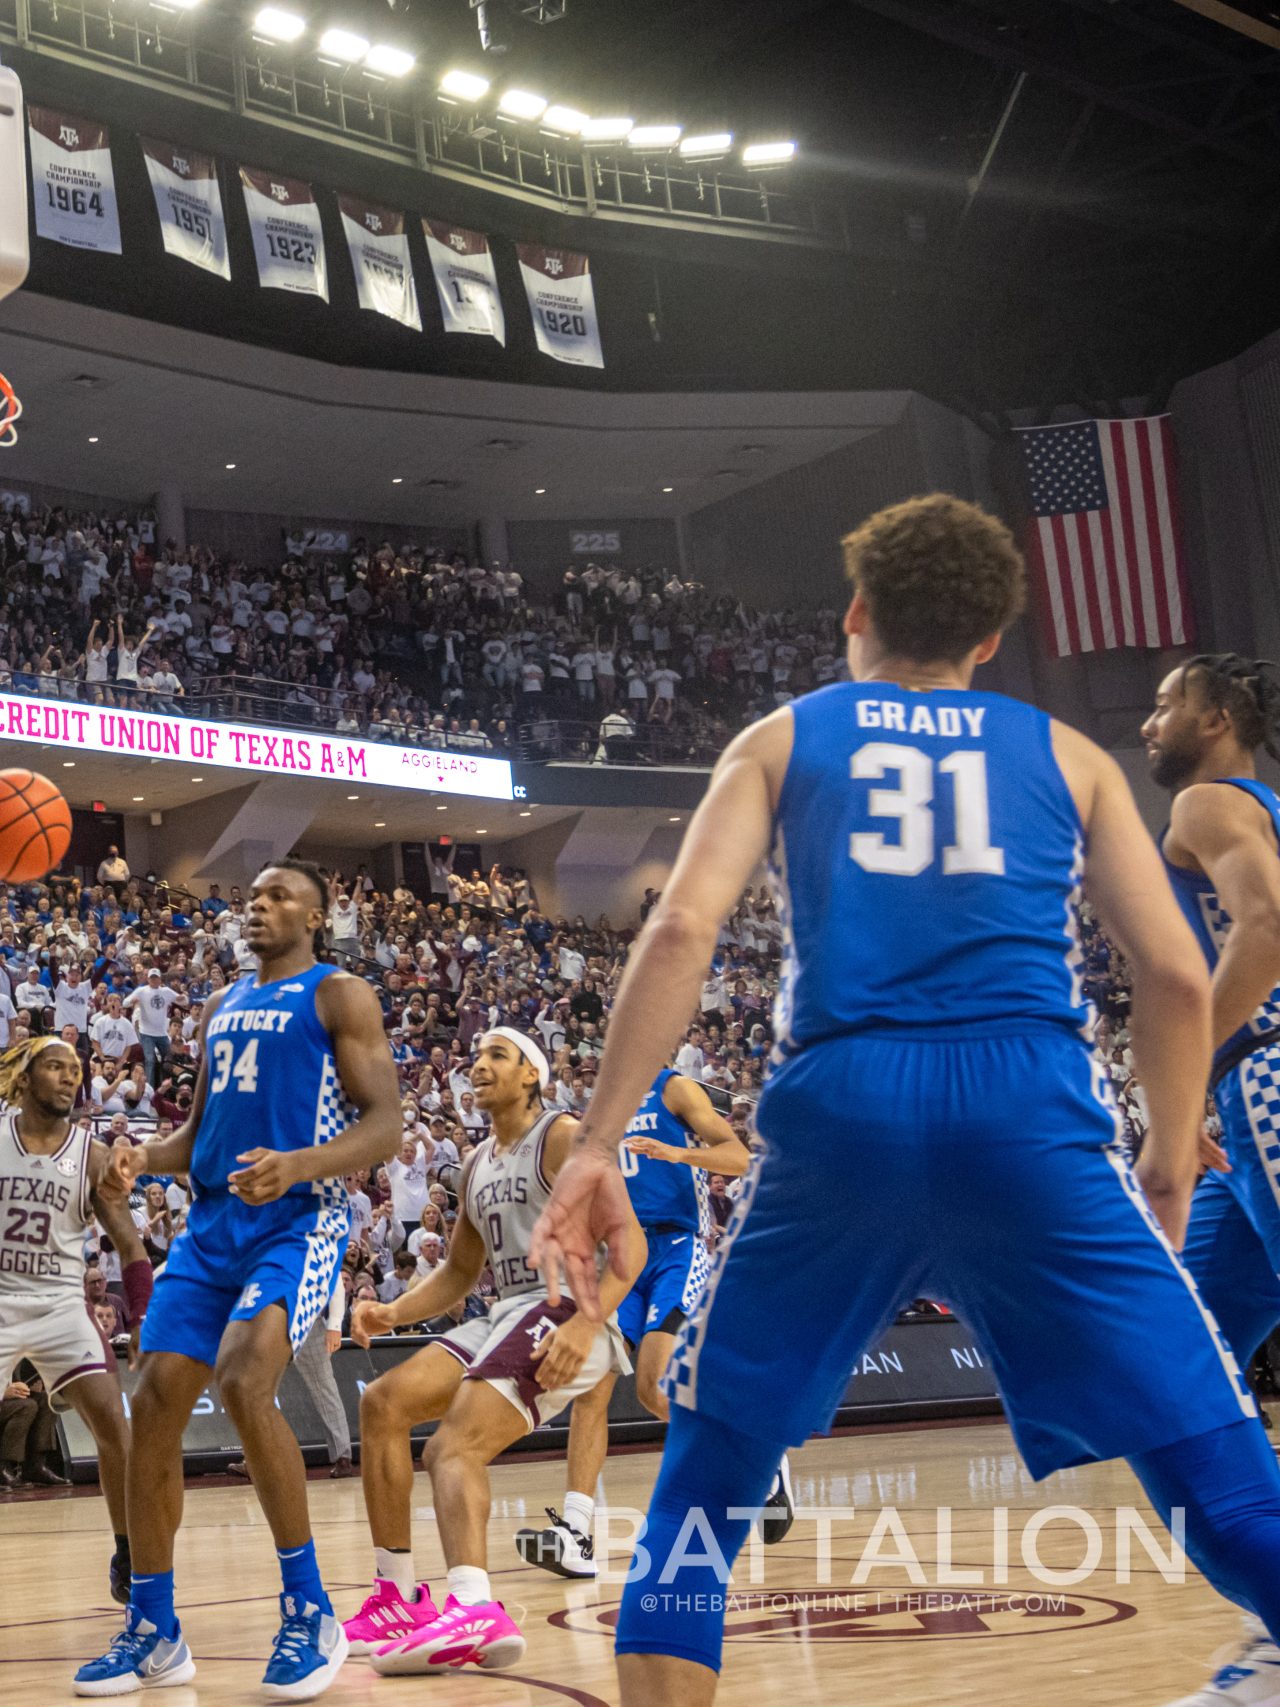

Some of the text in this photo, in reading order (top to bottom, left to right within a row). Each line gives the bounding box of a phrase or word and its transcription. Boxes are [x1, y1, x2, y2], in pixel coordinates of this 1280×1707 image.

[46, 170, 102, 188] CHAMPIONSHIP
[49, 163, 97, 179] CONFERENCE
[47, 182, 105, 218] 1964
[265, 223, 314, 239] CHAMPIONSHIP
[267, 216, 309, 231] CONFERENCE
[537, 307, 587, 337] 1920
[855, 699, 986, 738] GRADY
[99, 713, 180, 758] UNION
[190, 726, 220, 760] OF
[229, 730, 312, 771] TEXAS
[320, 742, 368, 778] A&M
[401, 751, 479, 774] AGGIELAND
[849, 741, 1006, 877] 31
[211, 1038, 260, 1094] 34
[3, 1207, 51, 1246] 23
[501, 1255, 540, 1287] IES
